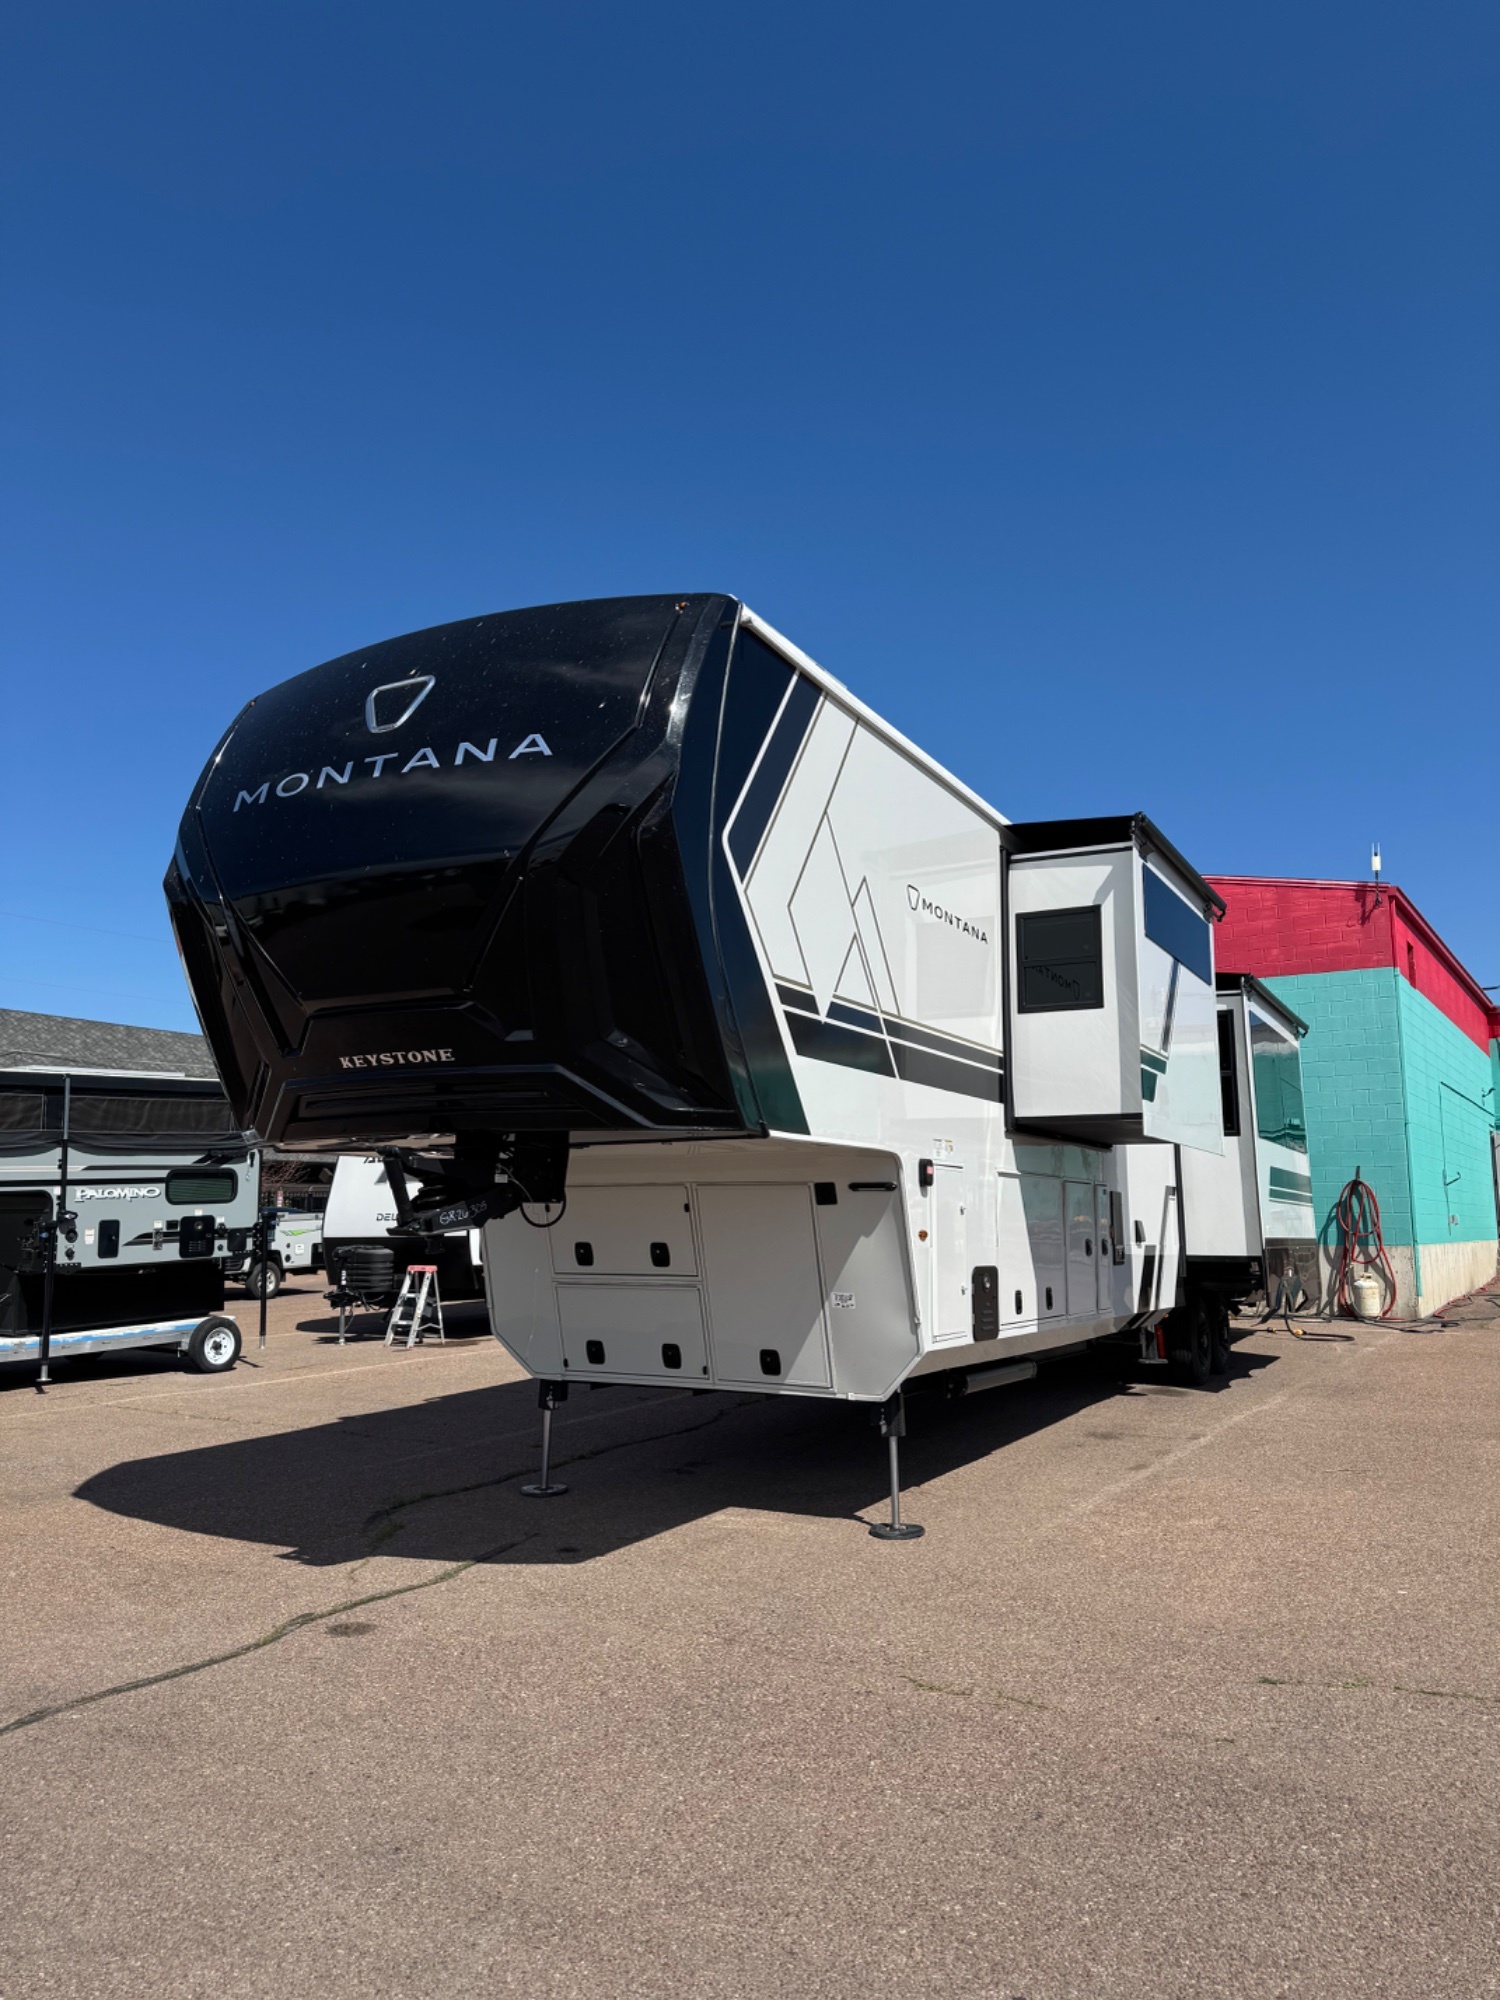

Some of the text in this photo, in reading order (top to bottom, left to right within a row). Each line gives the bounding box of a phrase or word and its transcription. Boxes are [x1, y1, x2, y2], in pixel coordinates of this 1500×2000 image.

[232, 733, 553, 812] MONTANA
[922, 897, 988, 944] MONTANA
[339, 1048, 455, 1068] KEYSTONE
[74, 1186, 162, 1202] PALOMINO
[376, 1213, 397, 1221] DEL
